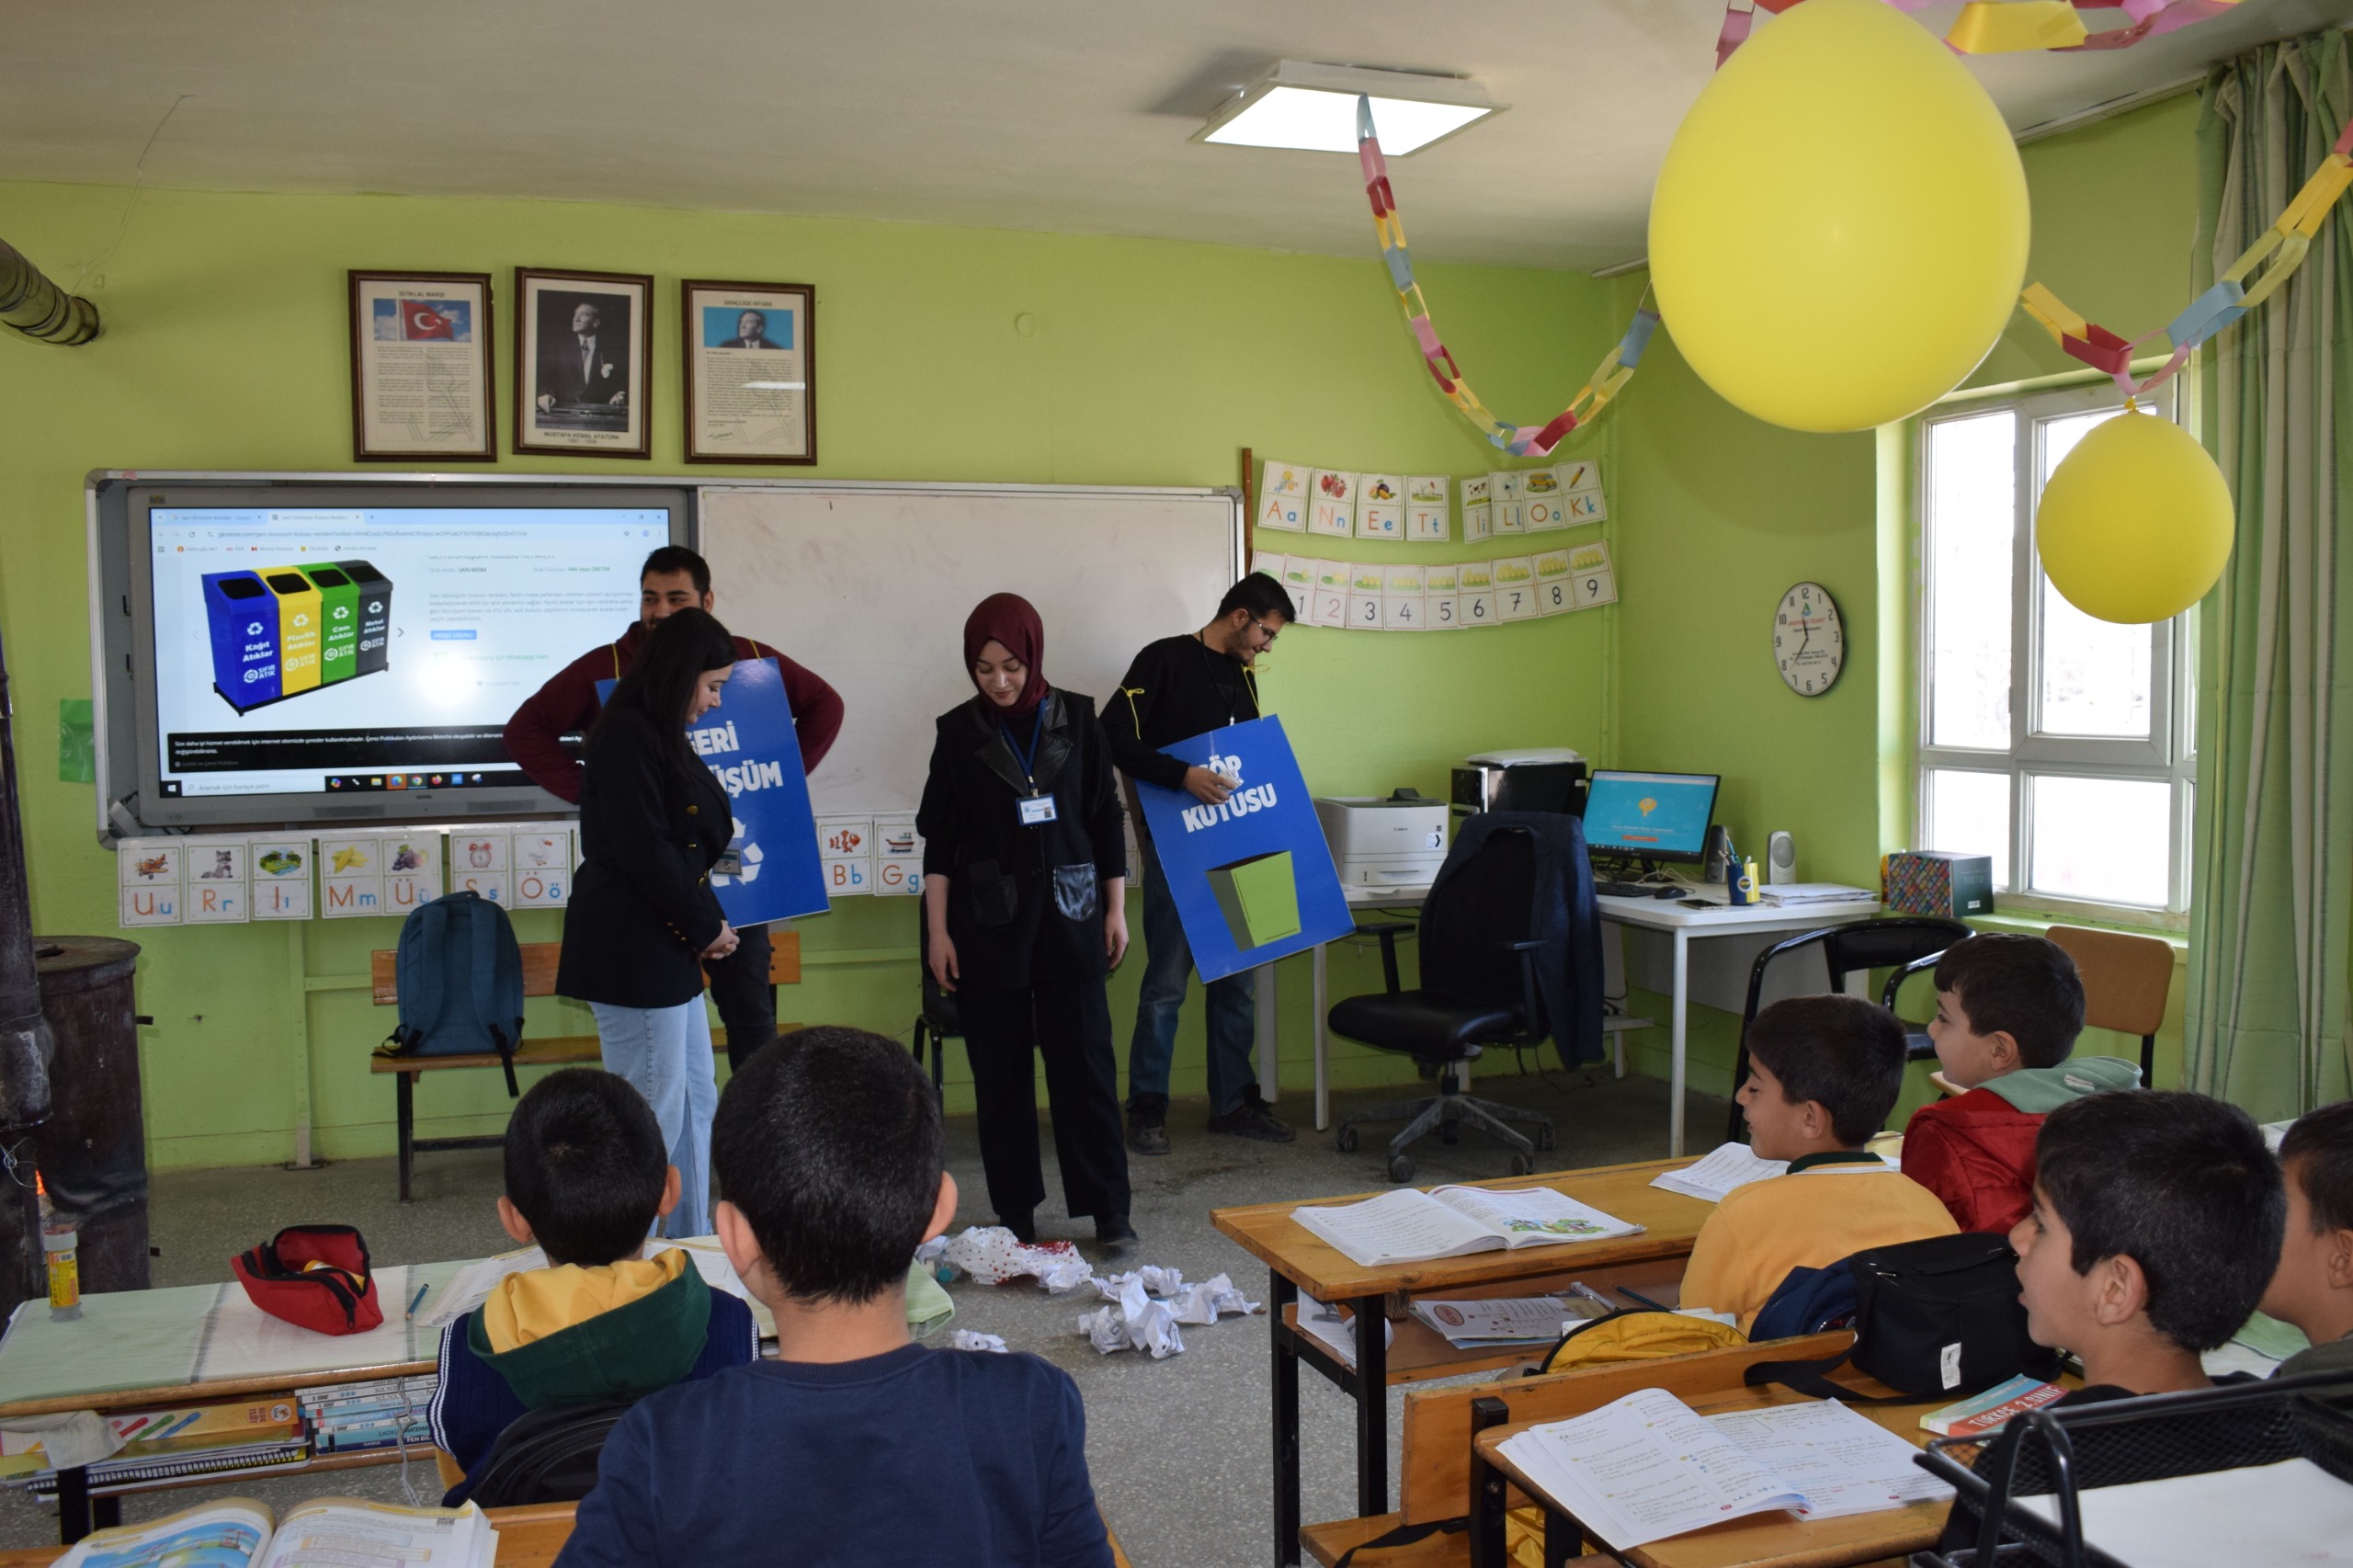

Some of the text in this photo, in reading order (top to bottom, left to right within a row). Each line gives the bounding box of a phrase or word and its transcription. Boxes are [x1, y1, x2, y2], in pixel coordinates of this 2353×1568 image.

[1802, 586, 1809, 599] 12
[1299, 579, 1597, 621] 1 2 3 4 5 6 7 8 9
[1789, 596, 1795, 608] 11
[1818, 593, 1822, 604] 1
[1779, 614, 1787, 625] 10
[1827, 608, 1834, 621] 2
[332, 624, 350, 632] Cam
[287, 631, 316, 642] Plastik
[328, 631, 355, 642] Atıklar
[1776, 636, 1781, 648] 9
[1834, 631, 1839, 643] 3
[244, 641, 270, 653] Kağıt
[287, 640, 315, 651] Atıklar
[243, 650, 273, 663] Atıklar
[1831, 656, 1837, 667] 4
[258, 664, 276, 674] SIFIR
[1781, 660, 1787, 671] 8
[258, 670, 276, 679] ATIK
[1822, 673, 1827, 685] 5
[1792, 675, 1798, 686] 7
[1806, 680, 1812, 691] 6
[1182, 783, 1277, 833] KUTUSU
